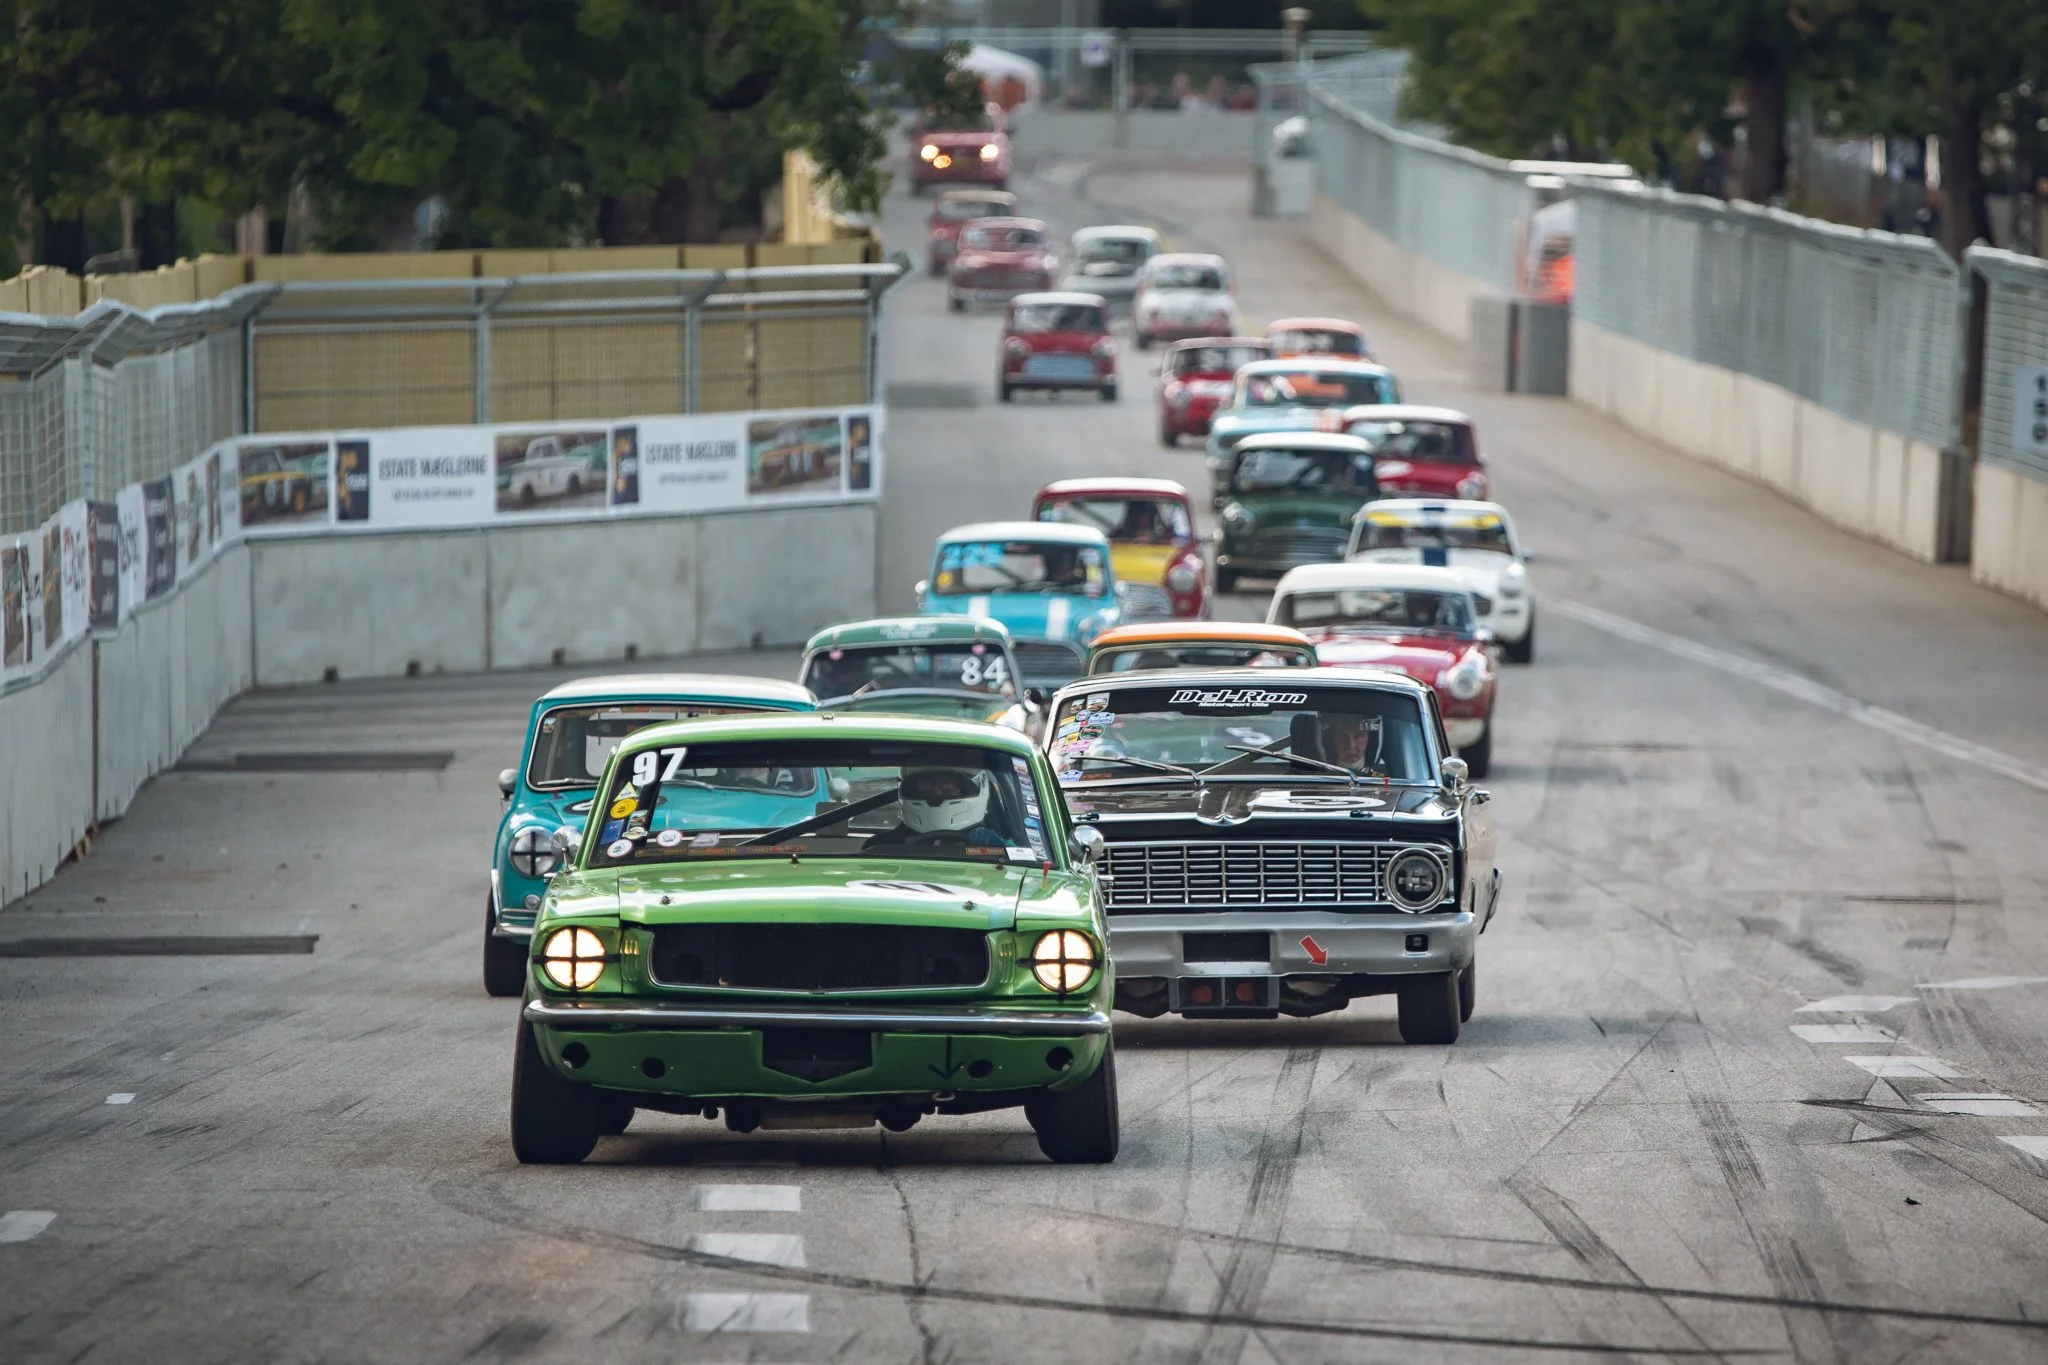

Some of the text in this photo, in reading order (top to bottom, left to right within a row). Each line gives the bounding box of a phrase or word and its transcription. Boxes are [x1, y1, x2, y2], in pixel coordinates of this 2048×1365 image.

[961, 655, 1009, 686] 84
[1168, 689, 1308, 704] Del-Ron
[632, 747, 687, 786] 97
